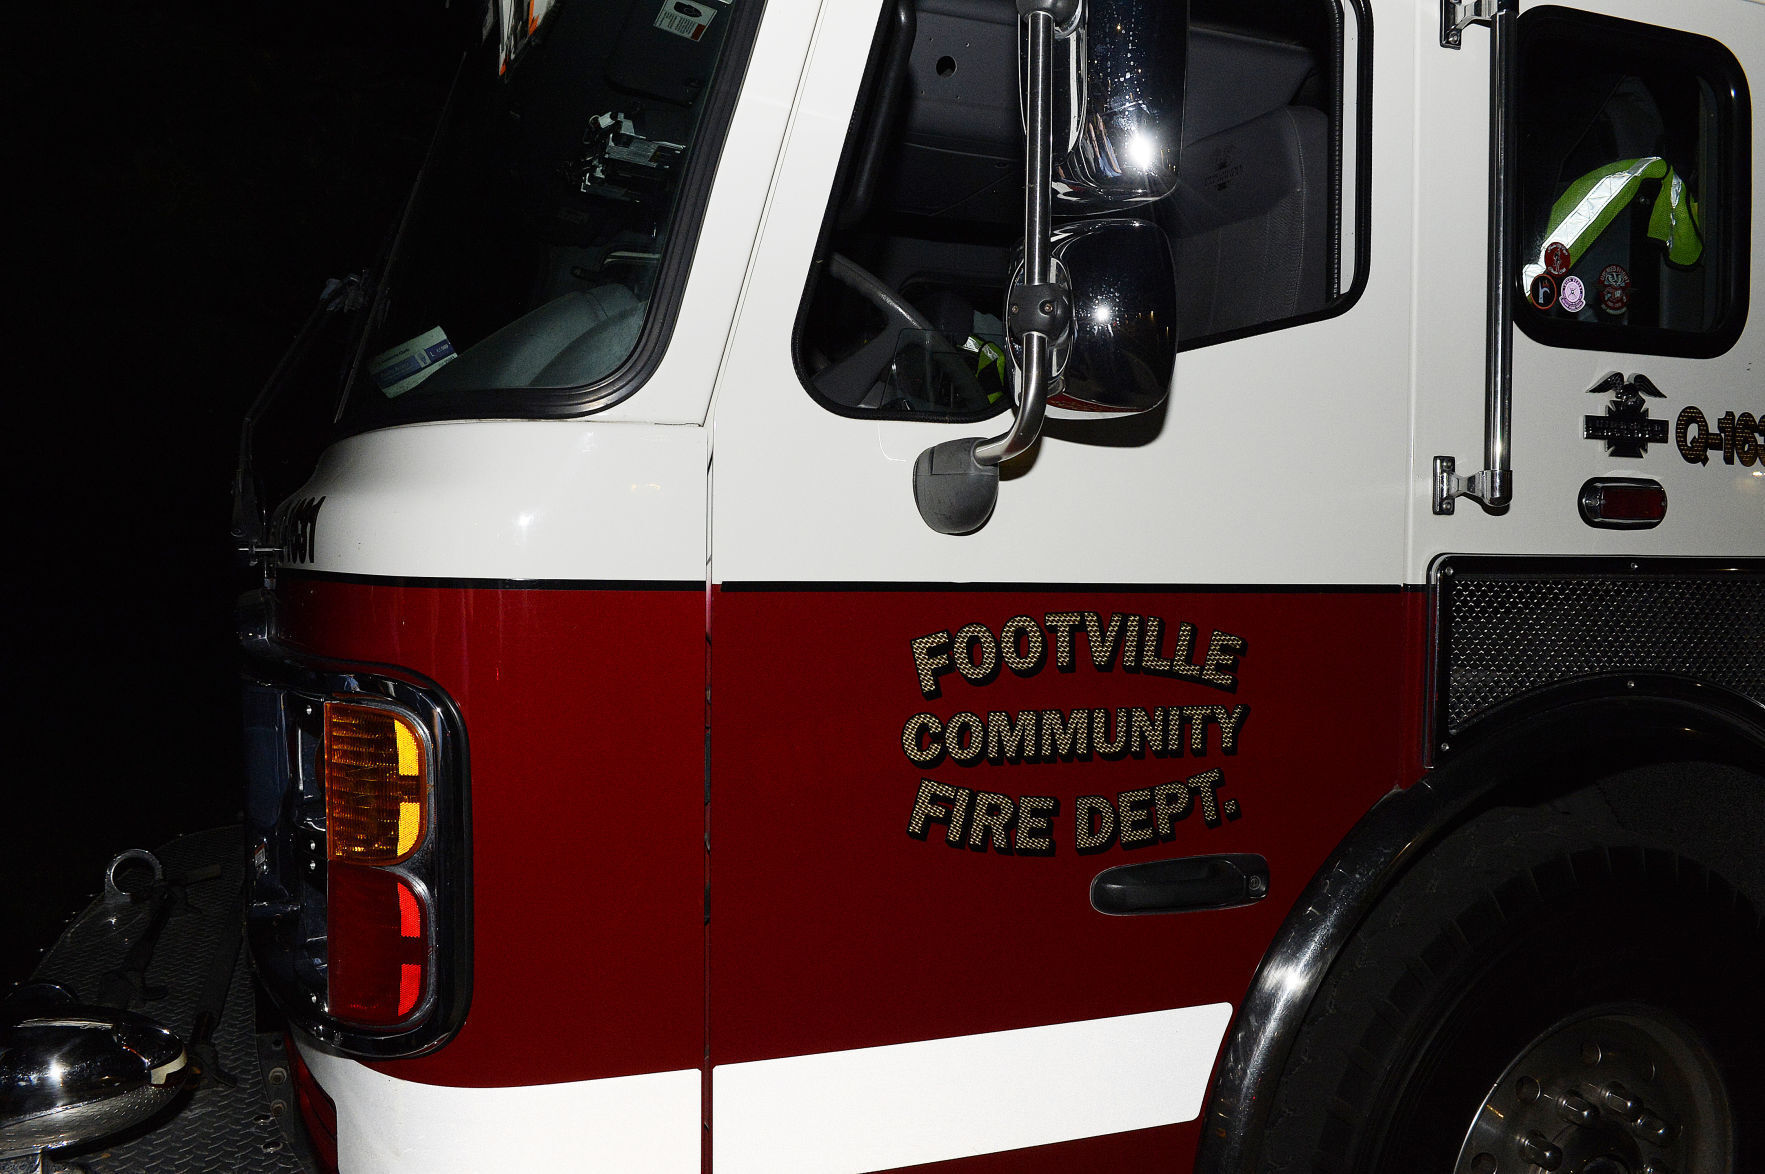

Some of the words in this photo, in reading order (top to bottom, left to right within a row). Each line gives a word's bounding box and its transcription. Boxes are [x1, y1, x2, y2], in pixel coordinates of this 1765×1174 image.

[911, 611, 1248, 700] FOOTVILLE
[902, 704, 1250, 769] COMMUNITY
[907, 777, 1060, 857] FIRE
[1076, 767, 1242, 855] DEPT.
